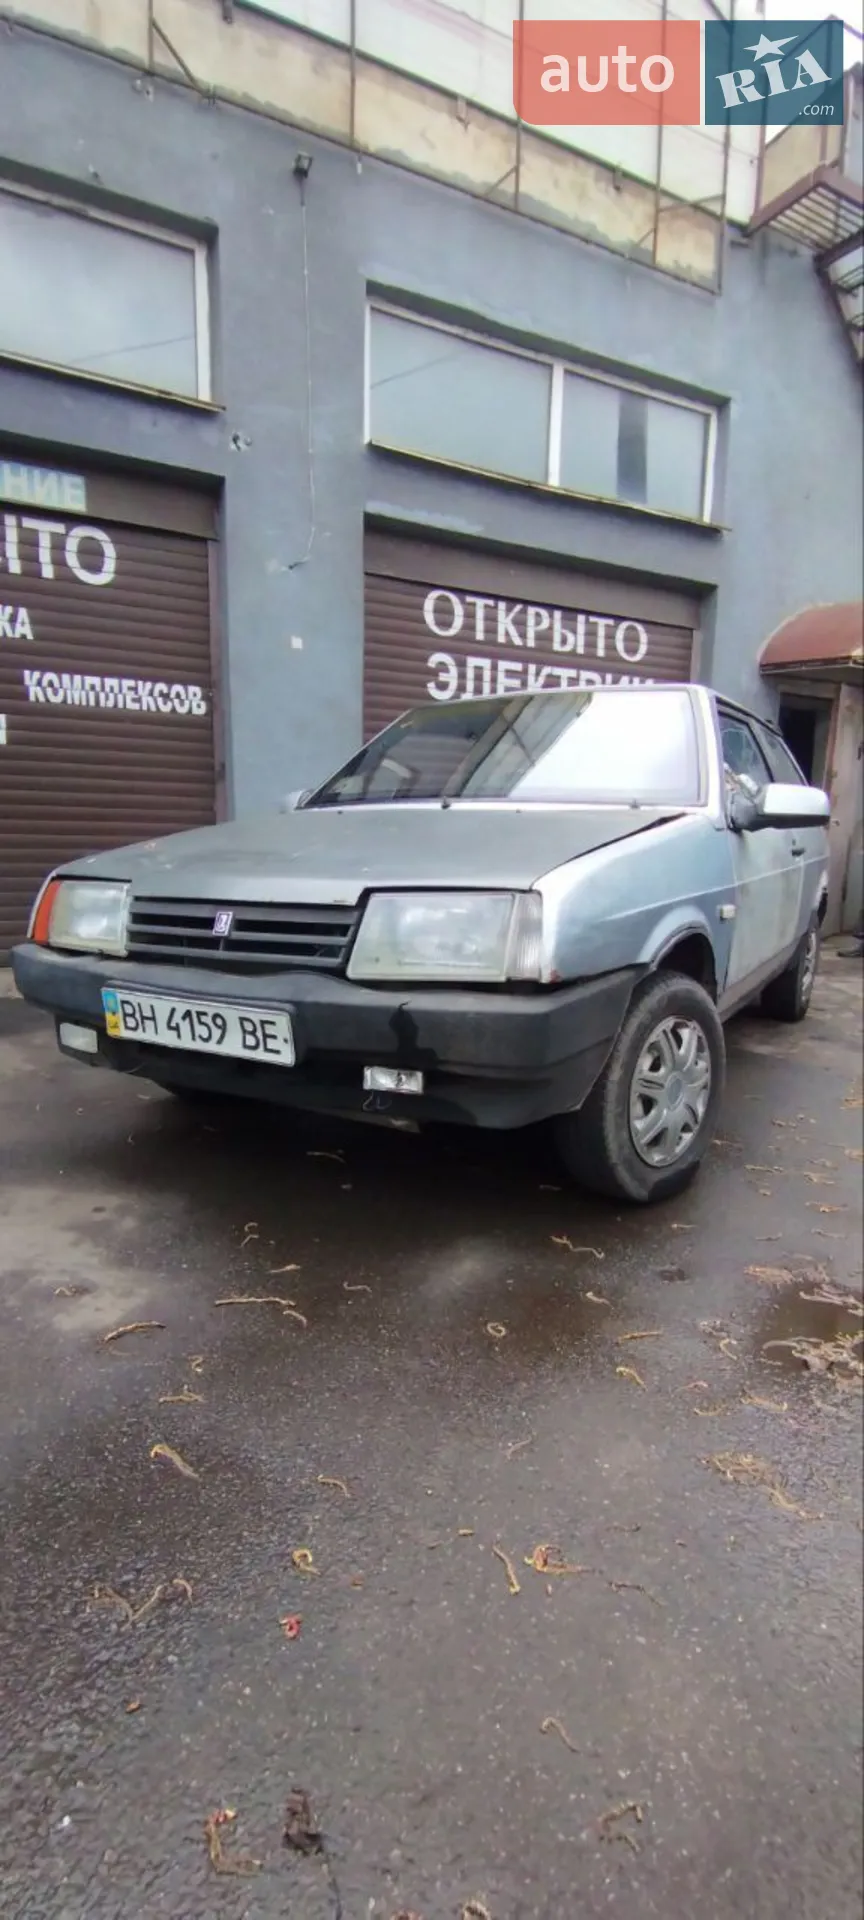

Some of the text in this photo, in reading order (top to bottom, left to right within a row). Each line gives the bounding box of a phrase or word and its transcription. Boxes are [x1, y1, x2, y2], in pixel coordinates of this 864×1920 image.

[423, 589, 648, 662] ОТКРЫТО
[23, 669, 207, 715] КОМПЛЕКСОВ
[120, 1000, 281, 1054] BH 4159 BE
